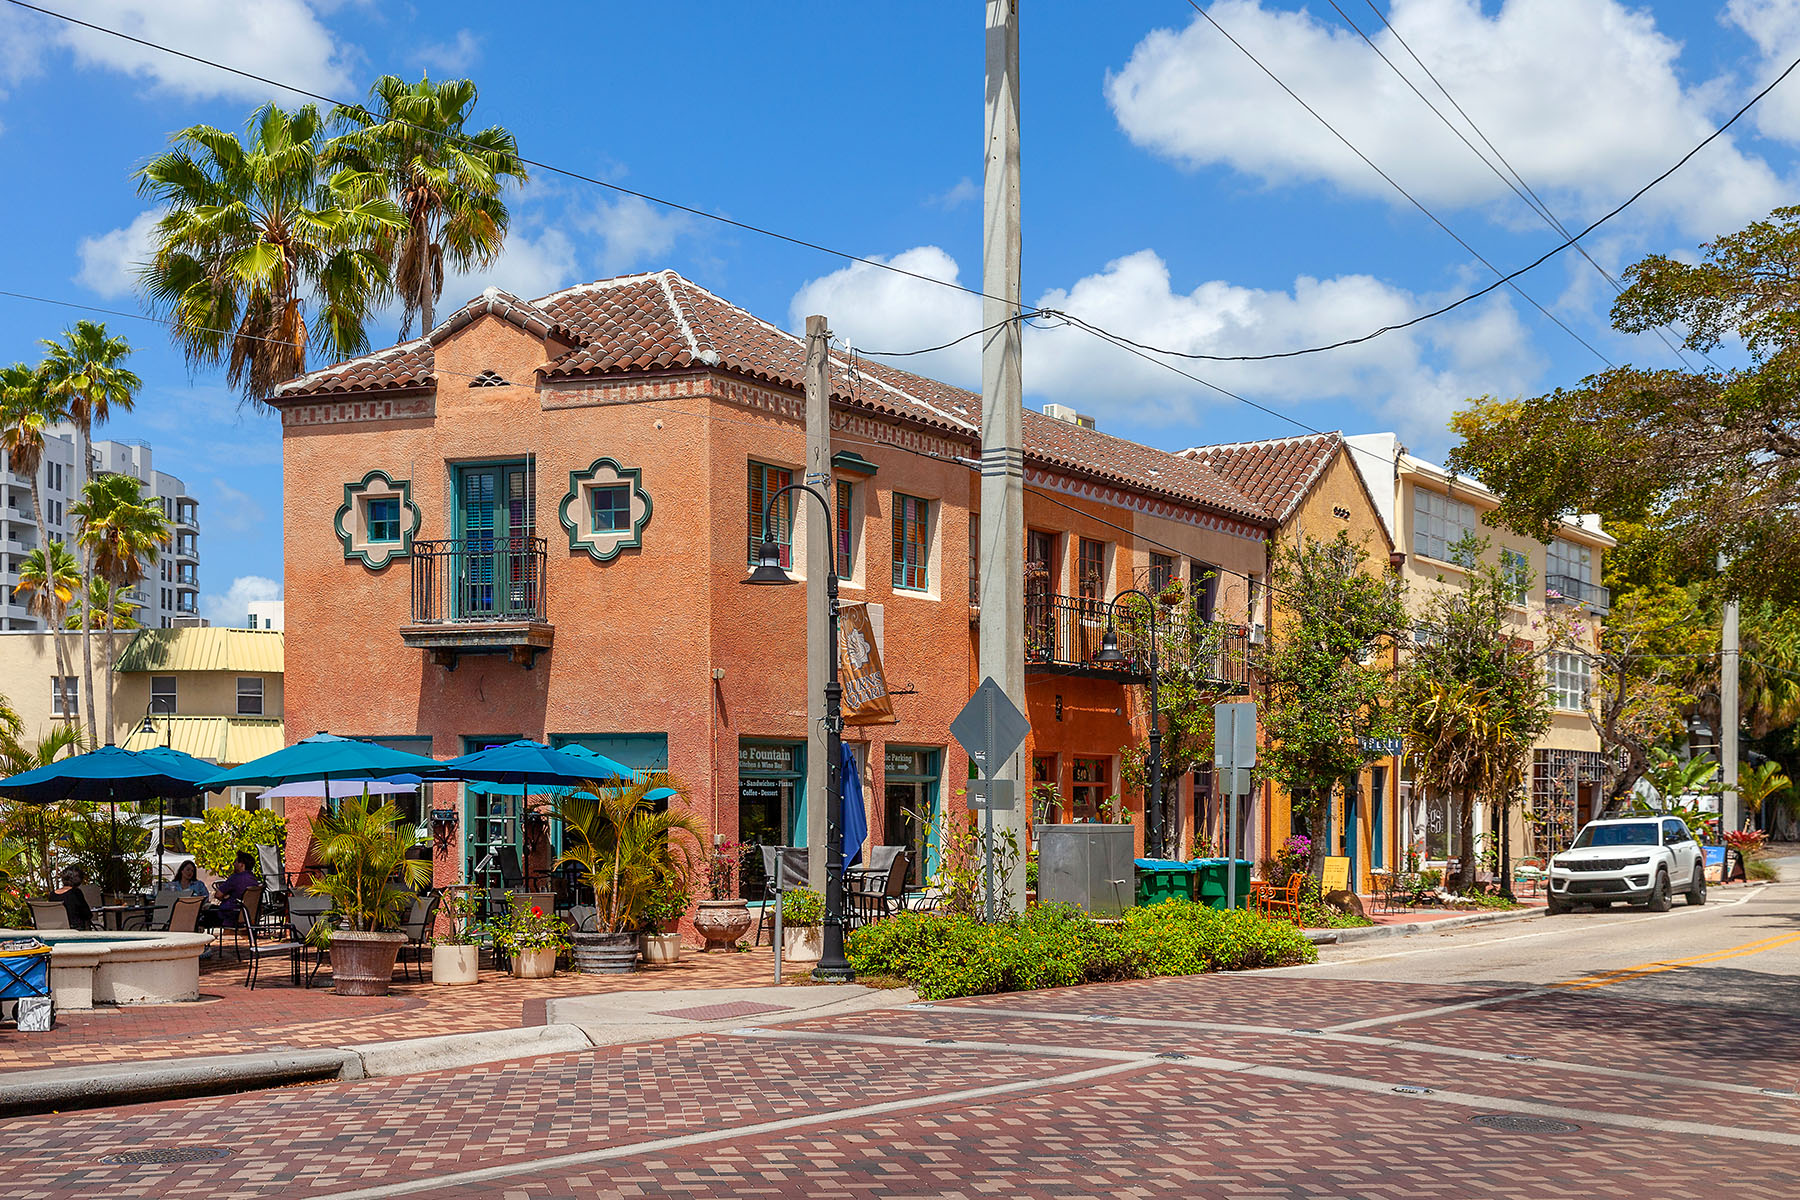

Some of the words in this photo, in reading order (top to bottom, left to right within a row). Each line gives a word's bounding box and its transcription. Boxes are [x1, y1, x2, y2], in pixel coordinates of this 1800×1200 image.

[845, 671, 883, 696] BURNS
[750, 748, 790, 760] Fountain
[892, 753, 912, 764] Parking
